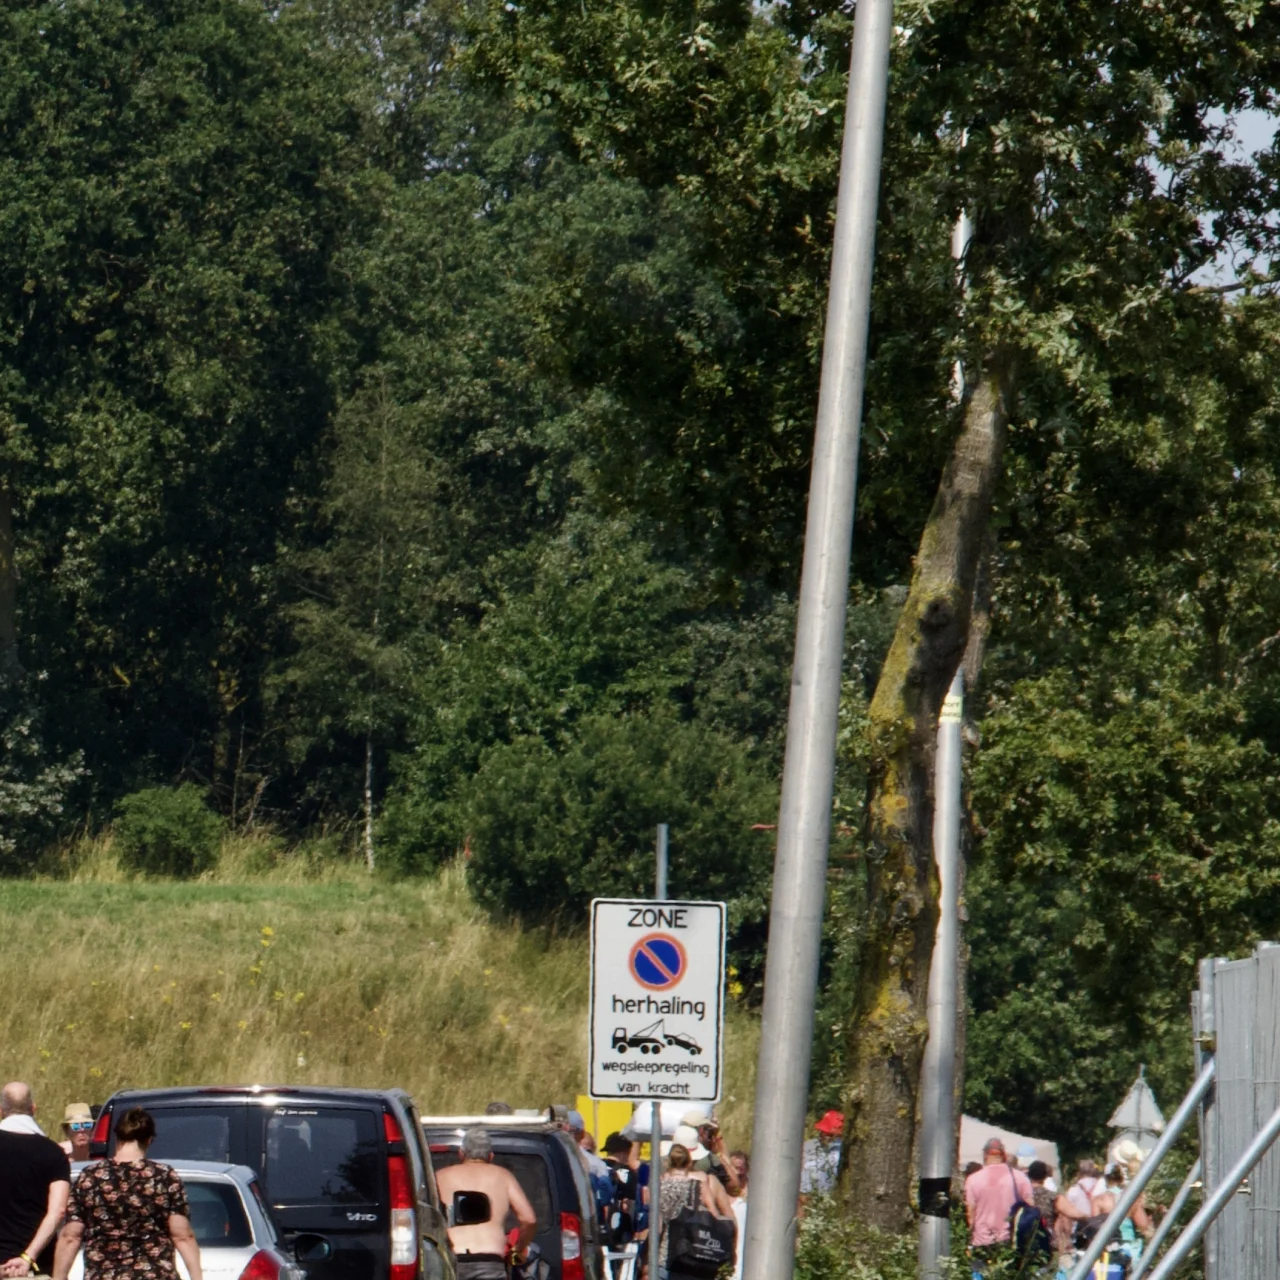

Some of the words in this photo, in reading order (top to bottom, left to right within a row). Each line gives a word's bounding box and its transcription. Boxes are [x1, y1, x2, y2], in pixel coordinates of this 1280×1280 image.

[628, 909, 688, 928] ZONE
[612, 994, 705, 1020] herhaling
[602, 1061, 710, 1077] wegsleepregeling
[618, 1082, 641, 1093] van
[648, 1081, 690, 1094] kracht
